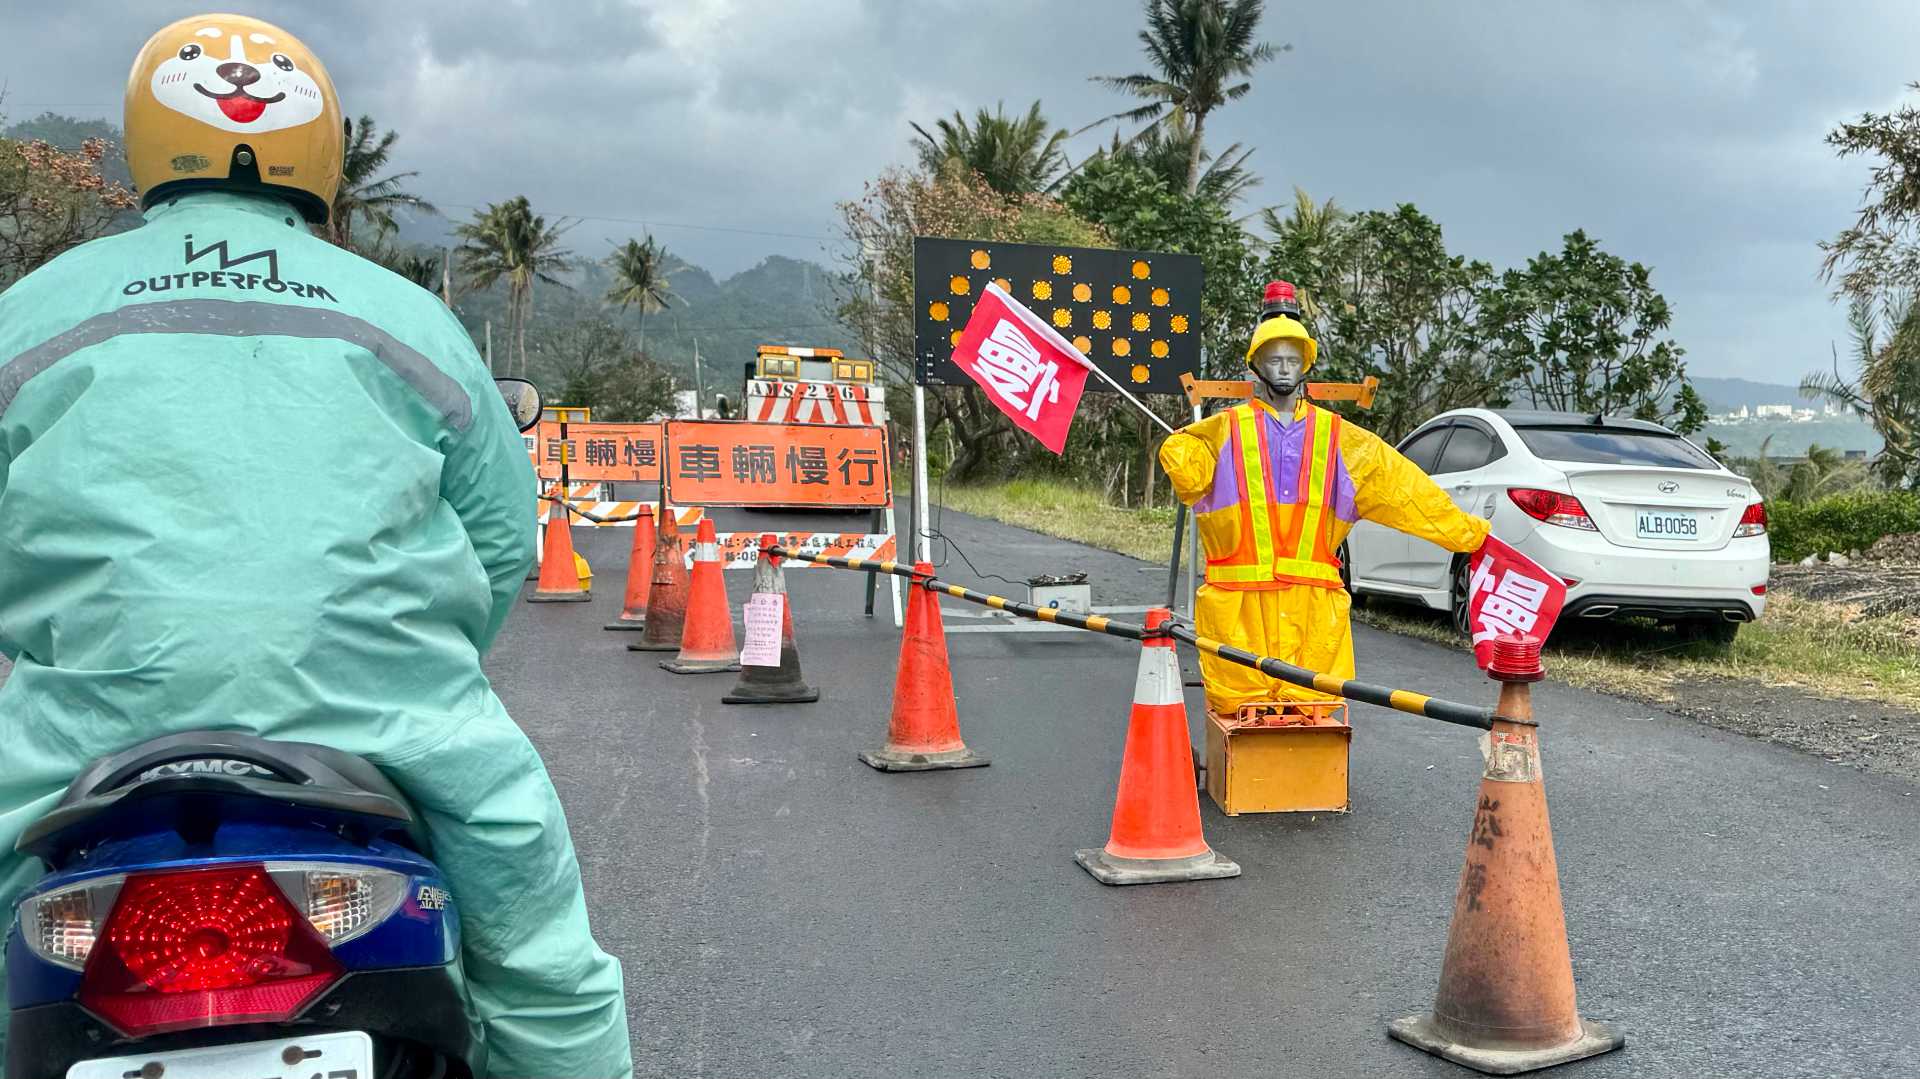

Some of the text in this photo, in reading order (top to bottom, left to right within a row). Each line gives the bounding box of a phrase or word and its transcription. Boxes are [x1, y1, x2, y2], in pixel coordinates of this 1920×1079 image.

[123, 271, 339, 303] OUTPERFORM
[679, 444, 879, 487] 車輛慢行
